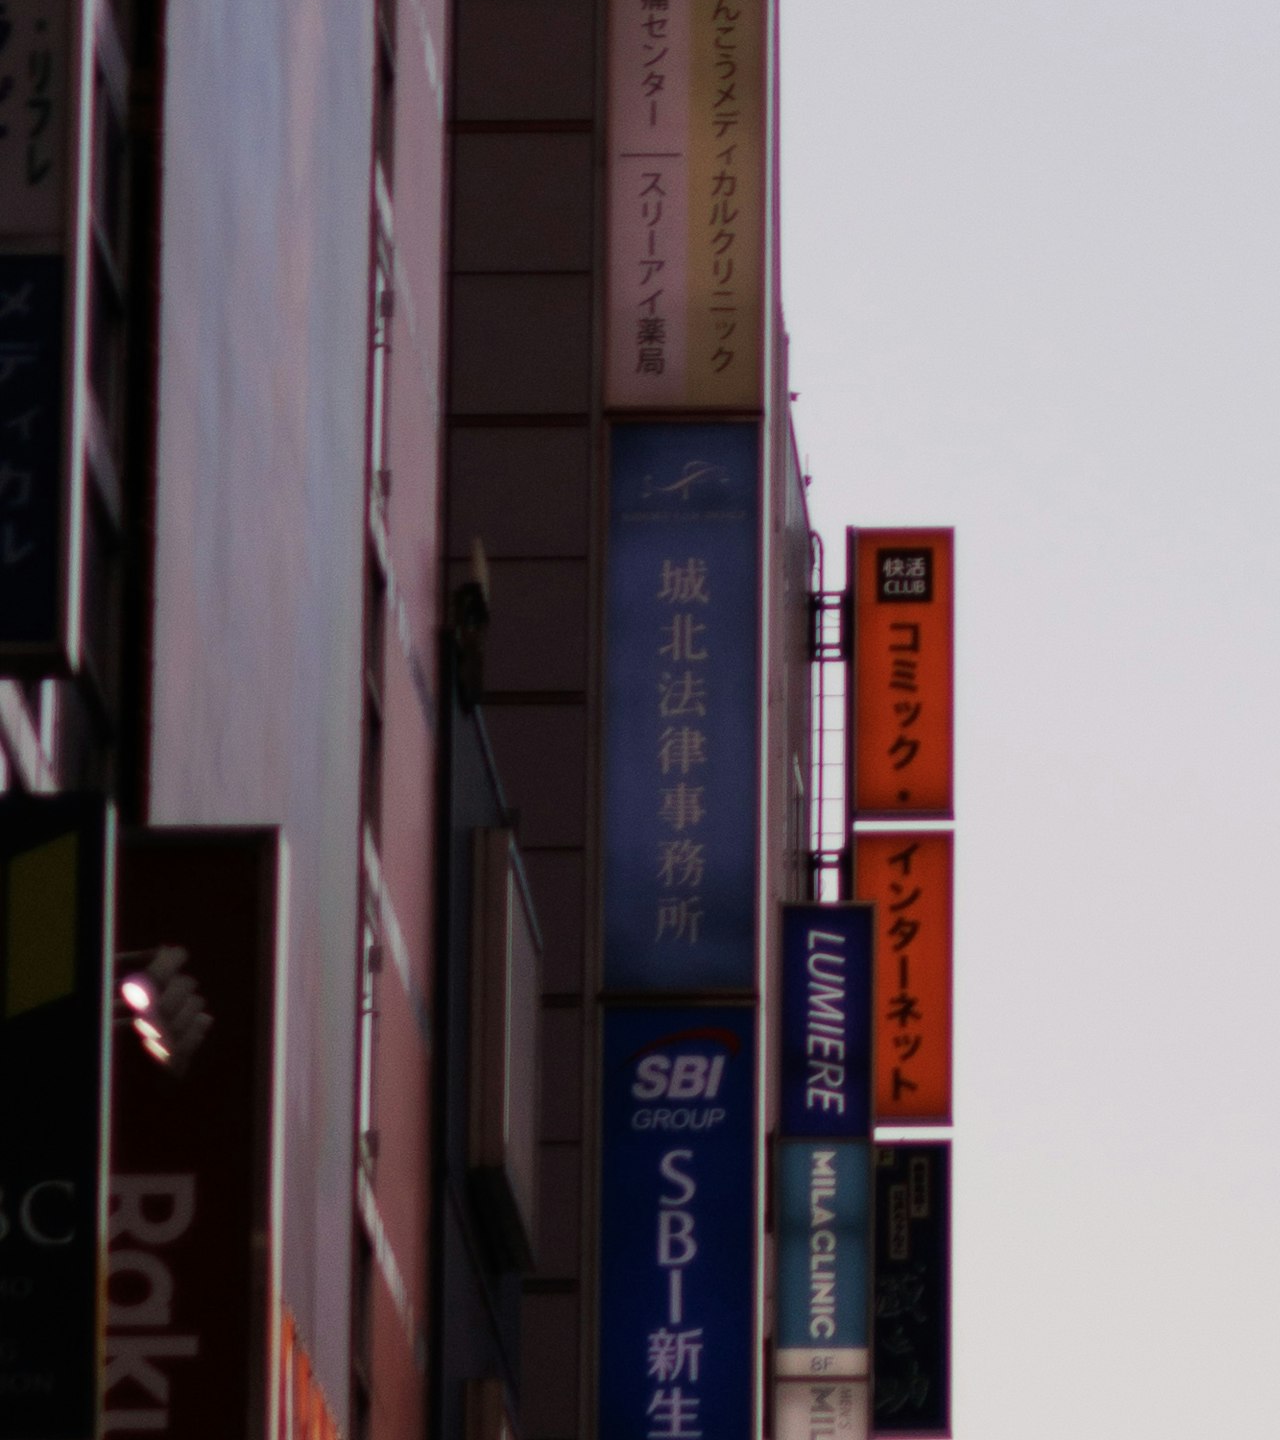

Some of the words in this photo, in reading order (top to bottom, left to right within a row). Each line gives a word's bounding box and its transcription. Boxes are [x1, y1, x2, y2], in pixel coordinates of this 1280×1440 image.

[637, 172, 667, 375] スリーアイ薬局
[882, 556, 926, 578] 快活
[883, 579, 926, 597] CLUB
[655, 557, 709, 945] 城北法律事務所
[807, 930, 846, 1115] LUMIERE
[886, 843, 922, 1102] インターネット
[631, 1053, 725, 1101] SBI
[631, 1107, 727, 1131] GROUP
